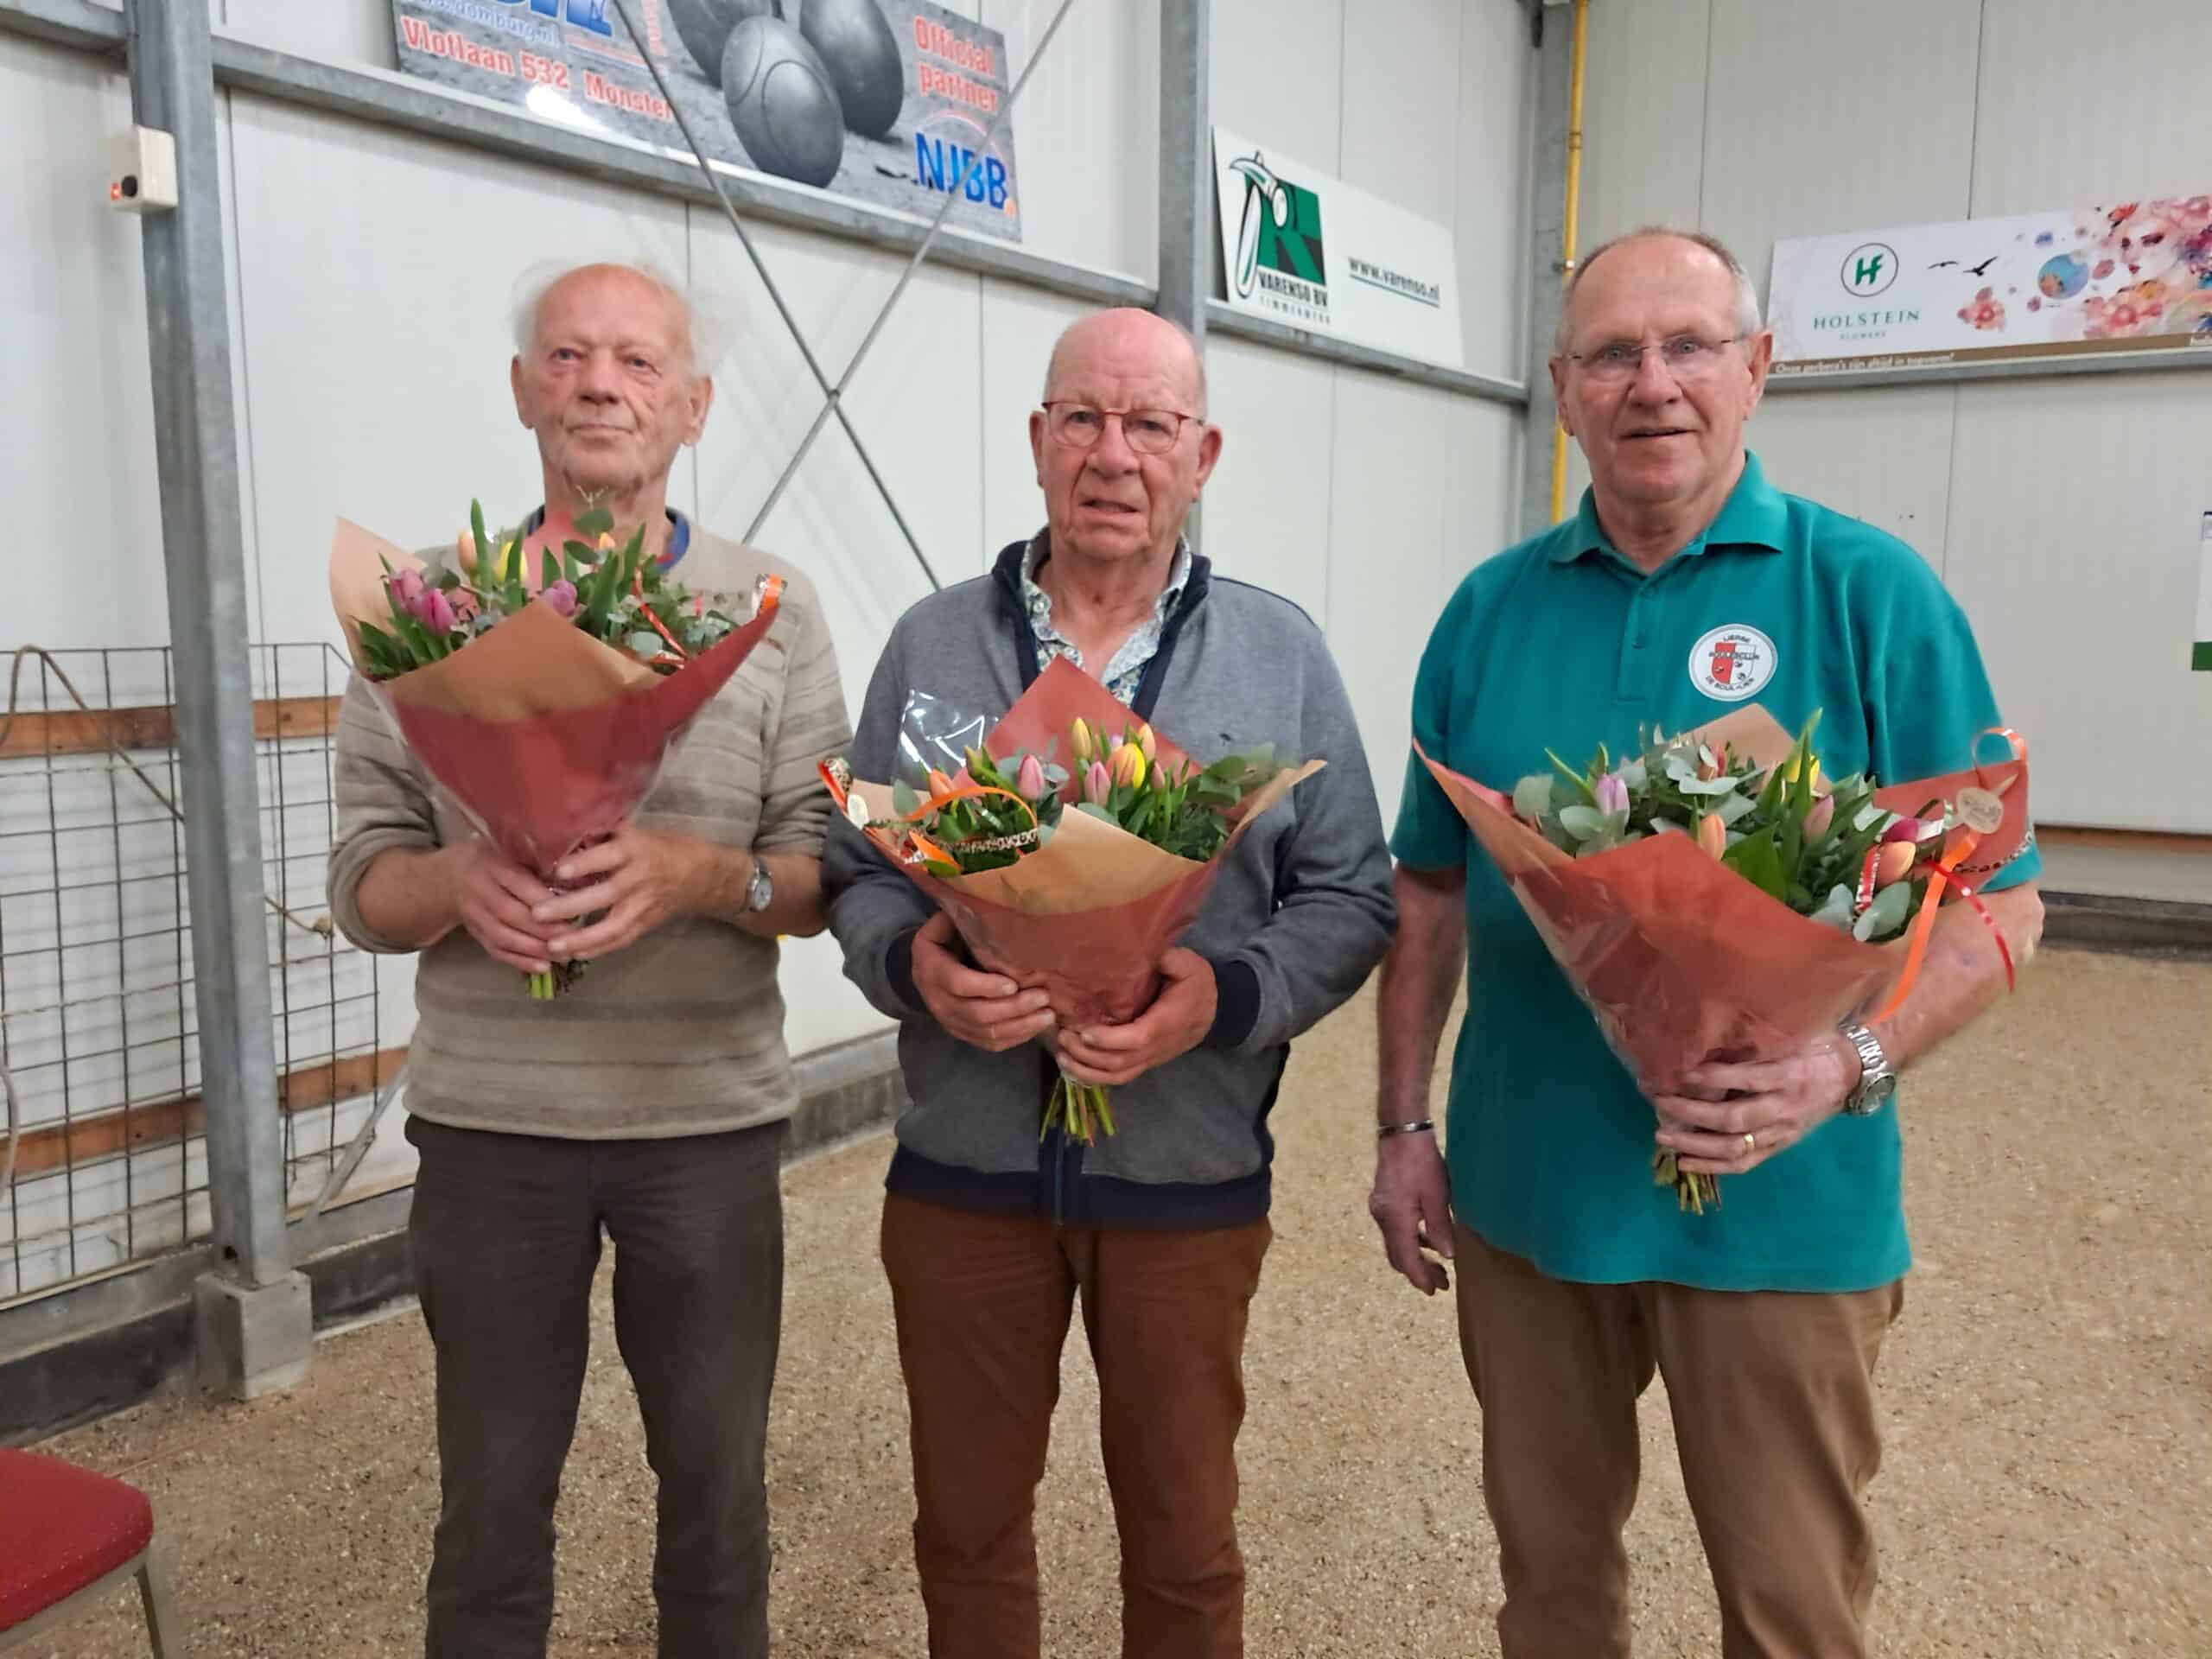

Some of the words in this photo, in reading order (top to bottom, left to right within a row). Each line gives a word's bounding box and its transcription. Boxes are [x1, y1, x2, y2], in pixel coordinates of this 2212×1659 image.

[401, 16, 515, 77] Vlotlaan
[519, 51, 569, 89] 532
[913, 16, 995, 76] Official
[918, 64, 998, 112] partner
[915, 132, 1007, 209] NJBB
[1258, 270, 1311, 302] VARENSO
[1348, 257, 1439, 301] www.varenso.nl
[1813, 310, 1920, 330] HOLSTEIN
